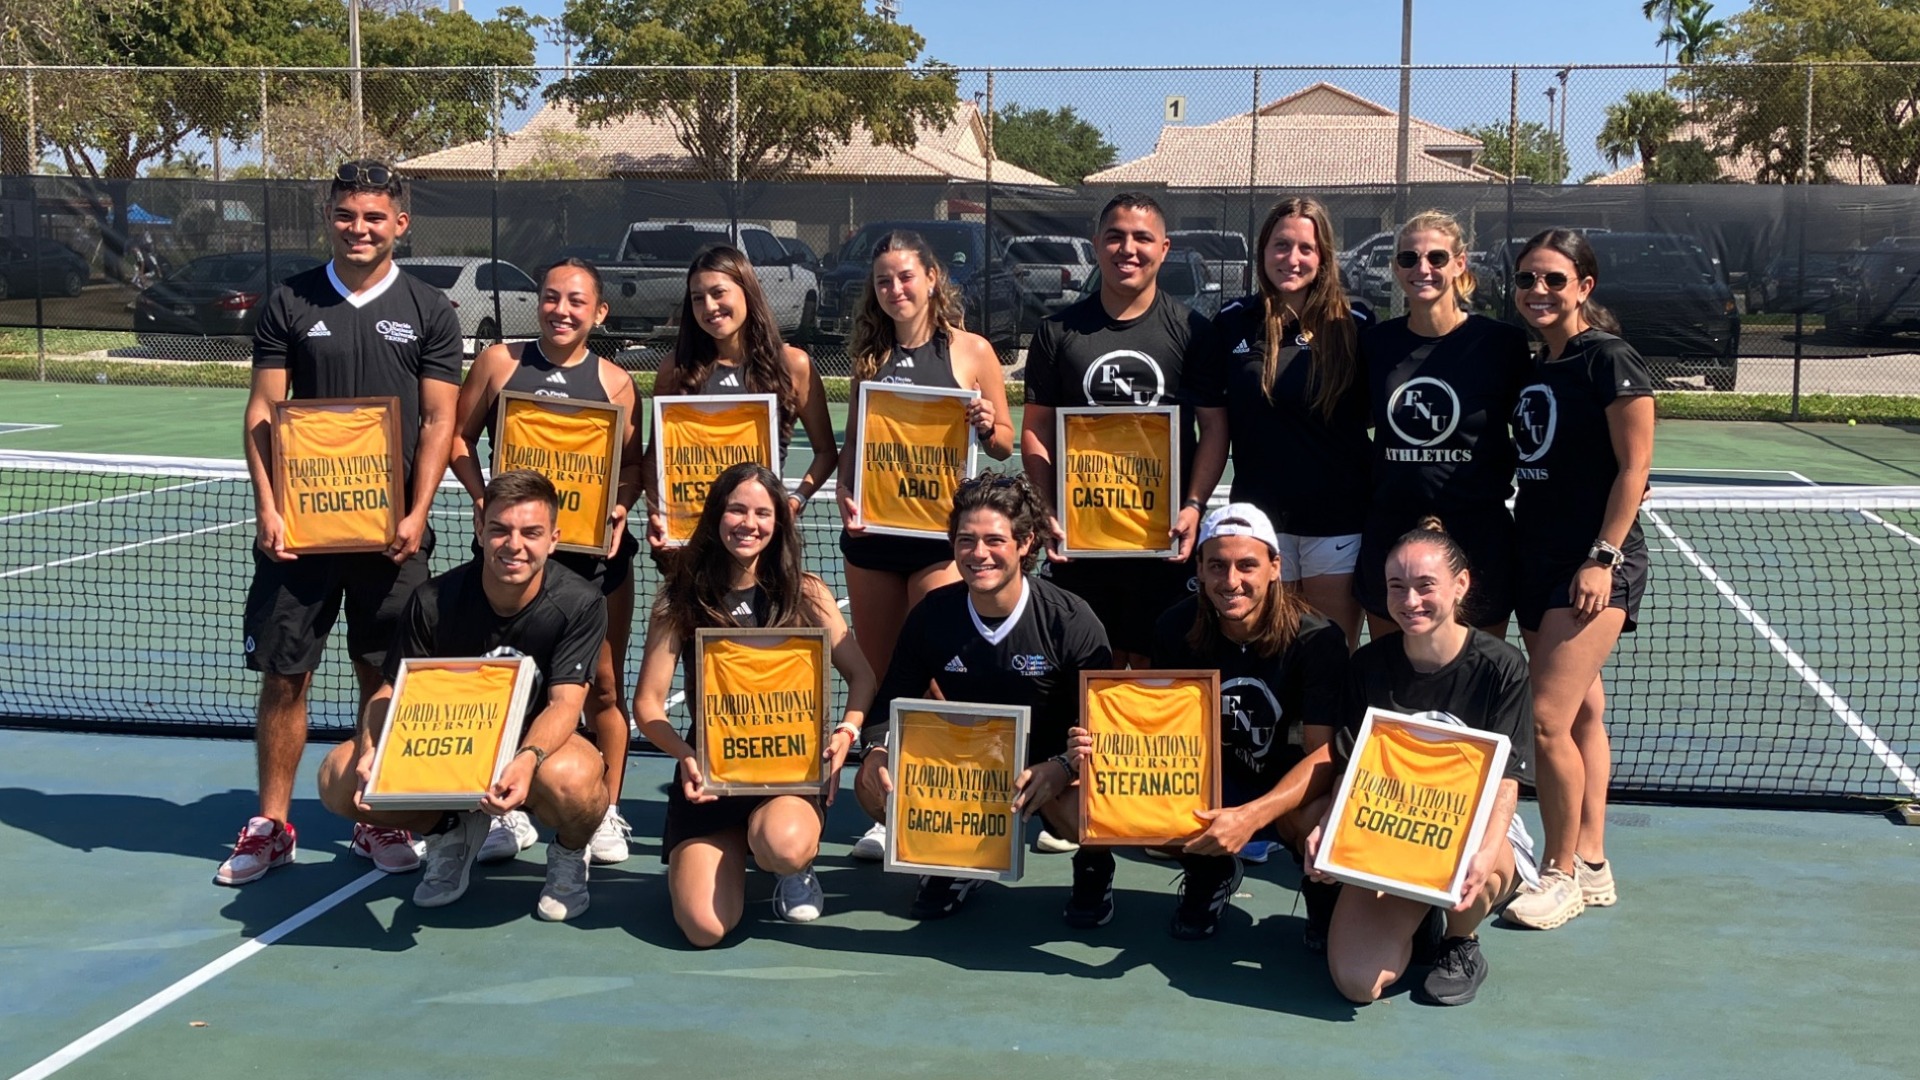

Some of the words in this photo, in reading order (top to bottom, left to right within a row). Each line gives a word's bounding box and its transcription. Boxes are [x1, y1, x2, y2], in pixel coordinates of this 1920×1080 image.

[1169, 100, 1179, 117] 1
[1100, 364, 1152, 405] FNU
[1402, 390, 1448, 432] FNU
[288, 457, 337, 478] FLORIDA
[338, 453, 393, 476] NATIONAL
[505, 443, 551, 469] FLORIDA
[555, 450, 607, 475] NATIONAL
[665, 446, 708, 467] FLORIDA
[709, 444, 763, 467] NATIONAL
[866, 442, 908, 463] FLORIDA
[912, 446, 960, 467] NATIONAL
[1066, 454, 1109, 474] FLORIDA
[1111, 456, 1163, 478] NATIONAL
[1385, 447, 1473, 462] ATHLETICS
[290, 473, 393, 488] UNIVERSITY
[867, 461, 958, 477] UNIVERSITY
[1065, 473, 1161, 487] UNIVERSITY
[1515, 467, 1550, 481] ENNIS
[298, 487, 390, 514] FIGUEROA
[898, 478, 940, 500] ABAD
[1073, 487, 1155, 510] CASTILLO
[396, 703, 440, 722] LORIDA
[444, 701, 498, 721] NATIONAL
[706, 692, 756, 716] FLORIDA
[758, 689, 816, 715] NATIONAL
[400, 719, 497, 731] NIVERSITY
[708, 710, 815, 727] UNIVERSITY
[401, 736, 474, 757] ACOSTA
[723, 734, 807, 760] BSERENI
[1144, 735, 1202, 758] NATIONAL
[905, 763, 954, 789] FLORIDA
[957, 767, 1011, 793] NATIONAL
[1096, 771, 1200, 796] STEFANACCI
[905, 785, 1011, 803] UNIVERSITY
[1353, 768, 1406, 803] FLORIDA
[1409, 784, 1468, 816] NATIONAL
[1350, 788, 1465, 827] UNIVERSITY
[908, 807, 1006, 837] GARCIA-PRADO
[1354, 805, 1453, 850] CORDERO
